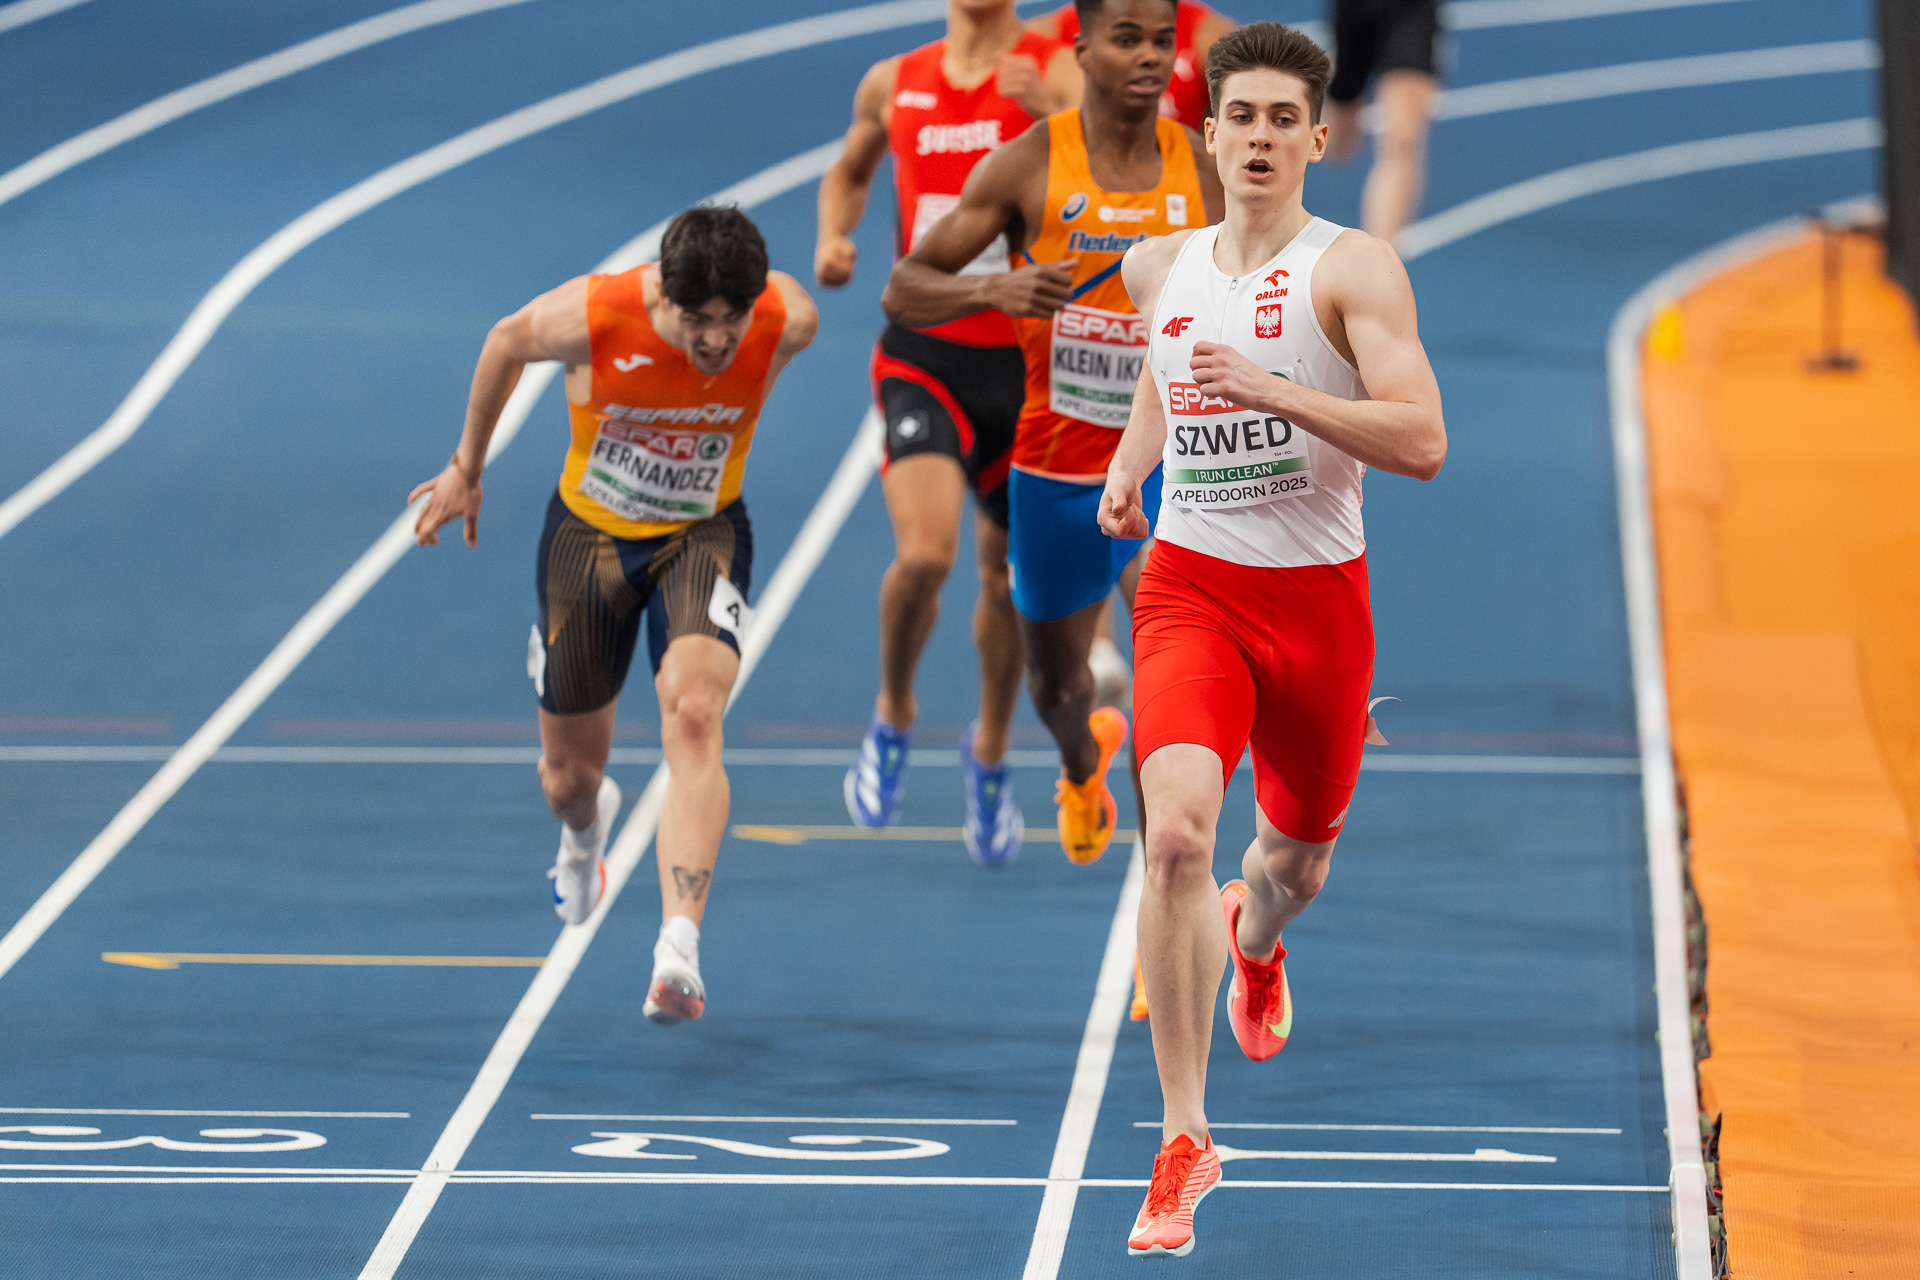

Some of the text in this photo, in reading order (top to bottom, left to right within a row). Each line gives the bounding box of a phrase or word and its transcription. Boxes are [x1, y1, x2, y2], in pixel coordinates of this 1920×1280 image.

[1255, 287, 1288, 301] ORLEN
[1161, 316, 1194, 338] 4F
[1055, 346, 1111, 378] KLEIN
[1170, 386, 1234, 411] SPA
[605, 420, 695, 457] SPAR
[1175, 416, 1292, 456] SZWED
[594, 439, 718, 492] FERNANDEZ
[1171, 476, 1308, 503] APELDOORN 2025
[571, 1131, 951, 1160] 2
